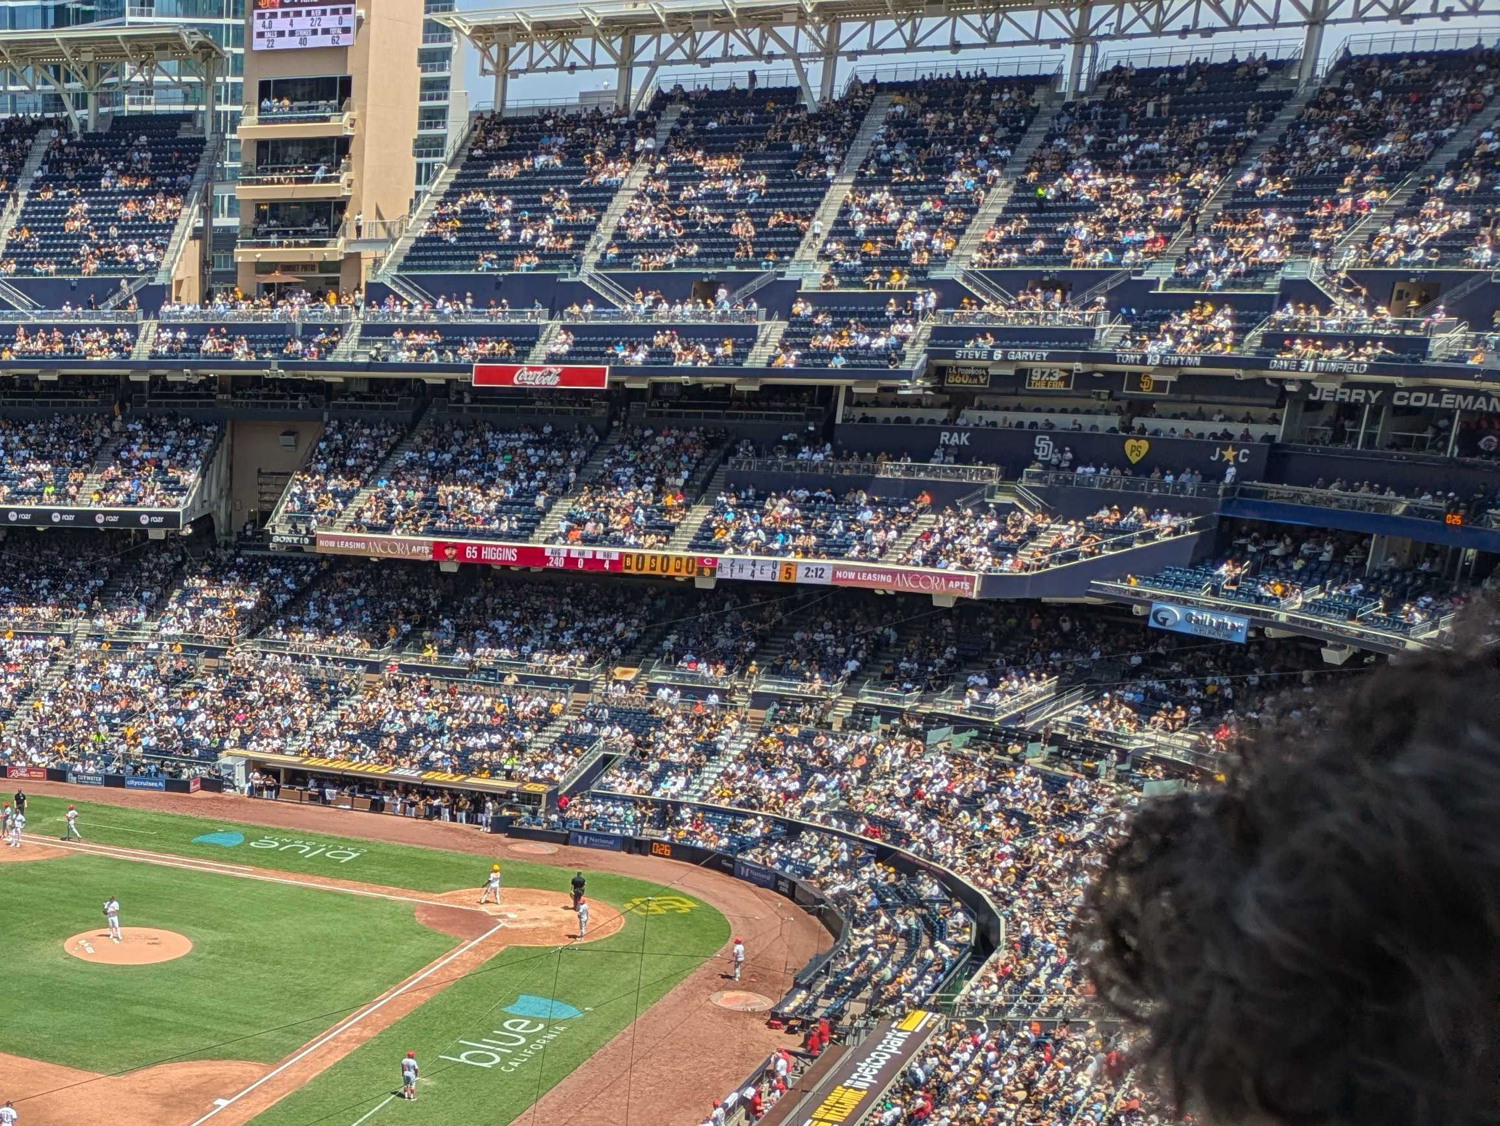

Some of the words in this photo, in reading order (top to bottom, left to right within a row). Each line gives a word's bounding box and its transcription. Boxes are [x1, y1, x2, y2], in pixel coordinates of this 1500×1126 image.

[262, 20, 272, 30] 4.0
[310, 18, 322, 26] 2/2
[266, 39, 274, 48] 22
[298, 37, 308, 46] 40
[331, 36, 340, 44] 62
[955, 350, 988, 360] STEVE
[992, 350, 1002, 361] 6
[1008, 351, 1049, 362] GARVEY
[1116, 354, 1142, 365] TONY
[1146, 354, 1160, 366] 19
[1162, 356, 1201, 366] GWYNN
[1269, 359, 1297, 370] DAVE
[1299, 360, 1316, 373] 31
[1316, 361, 1368, 374] WINFIELD
[1031, 380, 1047, 388] THE
[1308, 386, 1384, 404] JERRY
[1393, 391, 1500, 412] COLEMAN
[940, 431, 970, 446] RAK
[1129, 444, 1142, 457] PS
[272, 535, 299, 544] SONY
[319, 540, 336, 548] NOW
[336, 540, 366, 550] LEASING
[366, 540, 411, 556] ANCORA
[412, 545, 430, 554] APTS
[466, 546, 478, 559] 65
[481, 546, 518, 561] HIGGINS
[546, 557, 564, 568] .240
[578, 559, 584, 568] 0
[604, 560, 610, 570] 4
[784, 566, 792, 580] 5
[804, 567, 824, 579] 2:12
[836, 571, 856, 580] NOW
[857, 572, 892, 583] LEASING
[892, 572, 948, 591] ANCORA
[948, 580, 970, 590] APTS
[1185, 612, 1243, 632] Gallagher
[127, 779, 159, 788] citycruises
[589, 836, 614, 846] National
[250, 838, 361, 864] blue
[438, 1018, 545, 1068] blue
[500, 1025, 568, 1073] CALIFORNIA
[811, 1085, 868, 1122] WELCOME
[850, 1052, 891, 1084] petco
[876, 1027, 912, 1054] park
